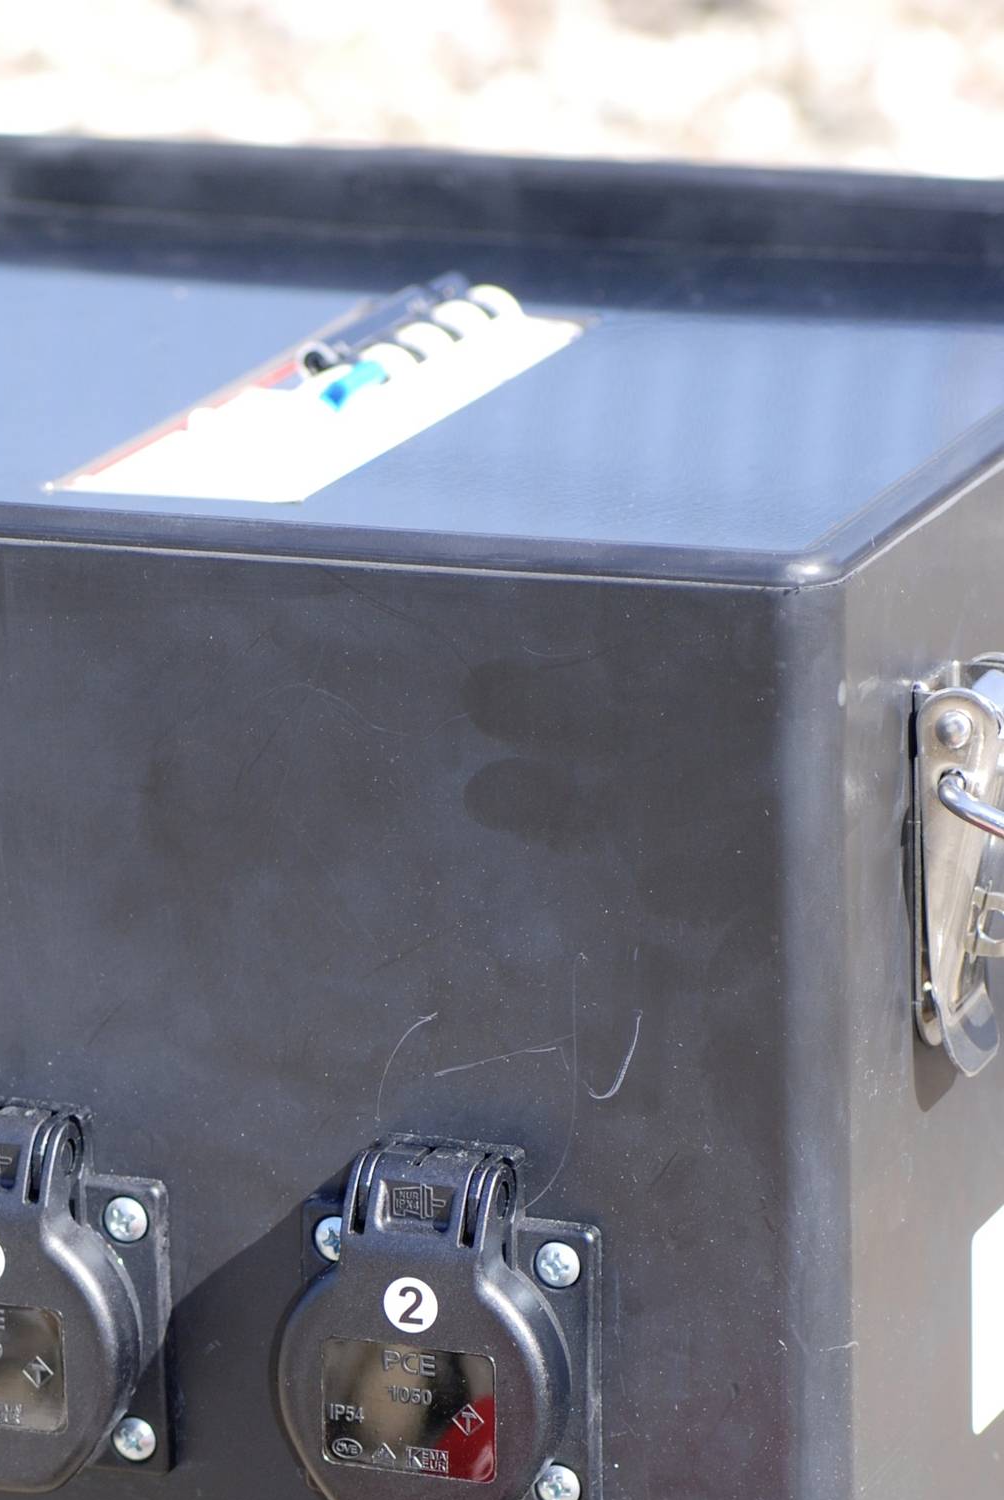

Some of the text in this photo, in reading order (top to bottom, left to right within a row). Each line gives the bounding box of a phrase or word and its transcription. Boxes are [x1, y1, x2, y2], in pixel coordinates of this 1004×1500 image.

[398, 1286, 424, 1325] 2
[382, 1350, 436, 1377] PCE
[388, 1385, 433, 1406] 1050
[329, 1403, 364, 1424] IP54
